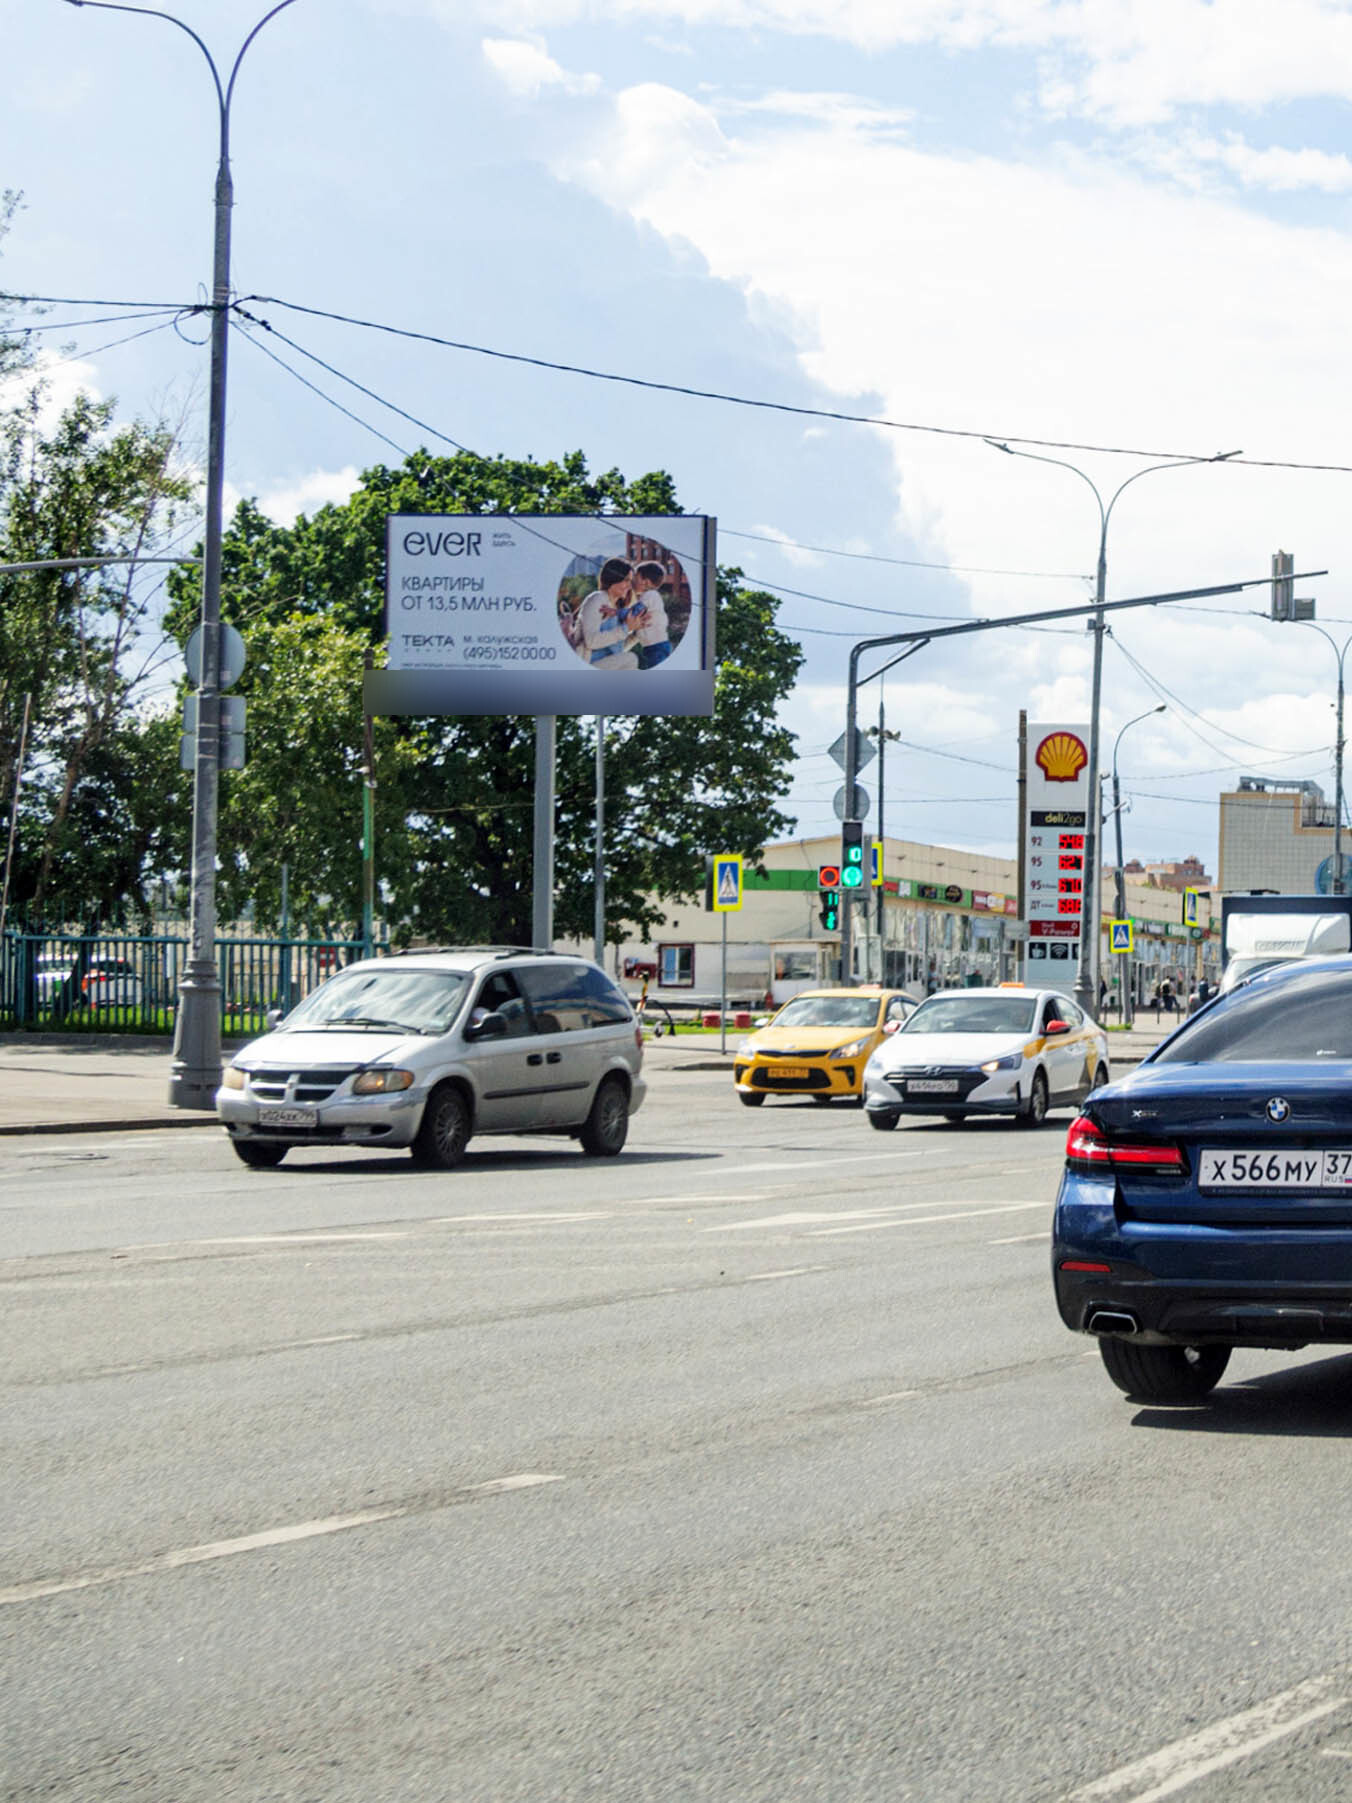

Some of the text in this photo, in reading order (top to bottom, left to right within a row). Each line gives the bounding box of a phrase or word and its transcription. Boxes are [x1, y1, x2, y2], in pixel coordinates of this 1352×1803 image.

[401, 576, 484, 591] КВАРТИРЫ
[401, 596, 537, 612] ОТ 13,5 МЛН РУБ.
[1045, 813, 1082, 826] deli2go
[1031, 836, 1042, 846] 92
[1031, 856, 1042, 867] 95
[1031, 880, 1041, 890] 95
[1327, 1154, 1352, 1174] 37
